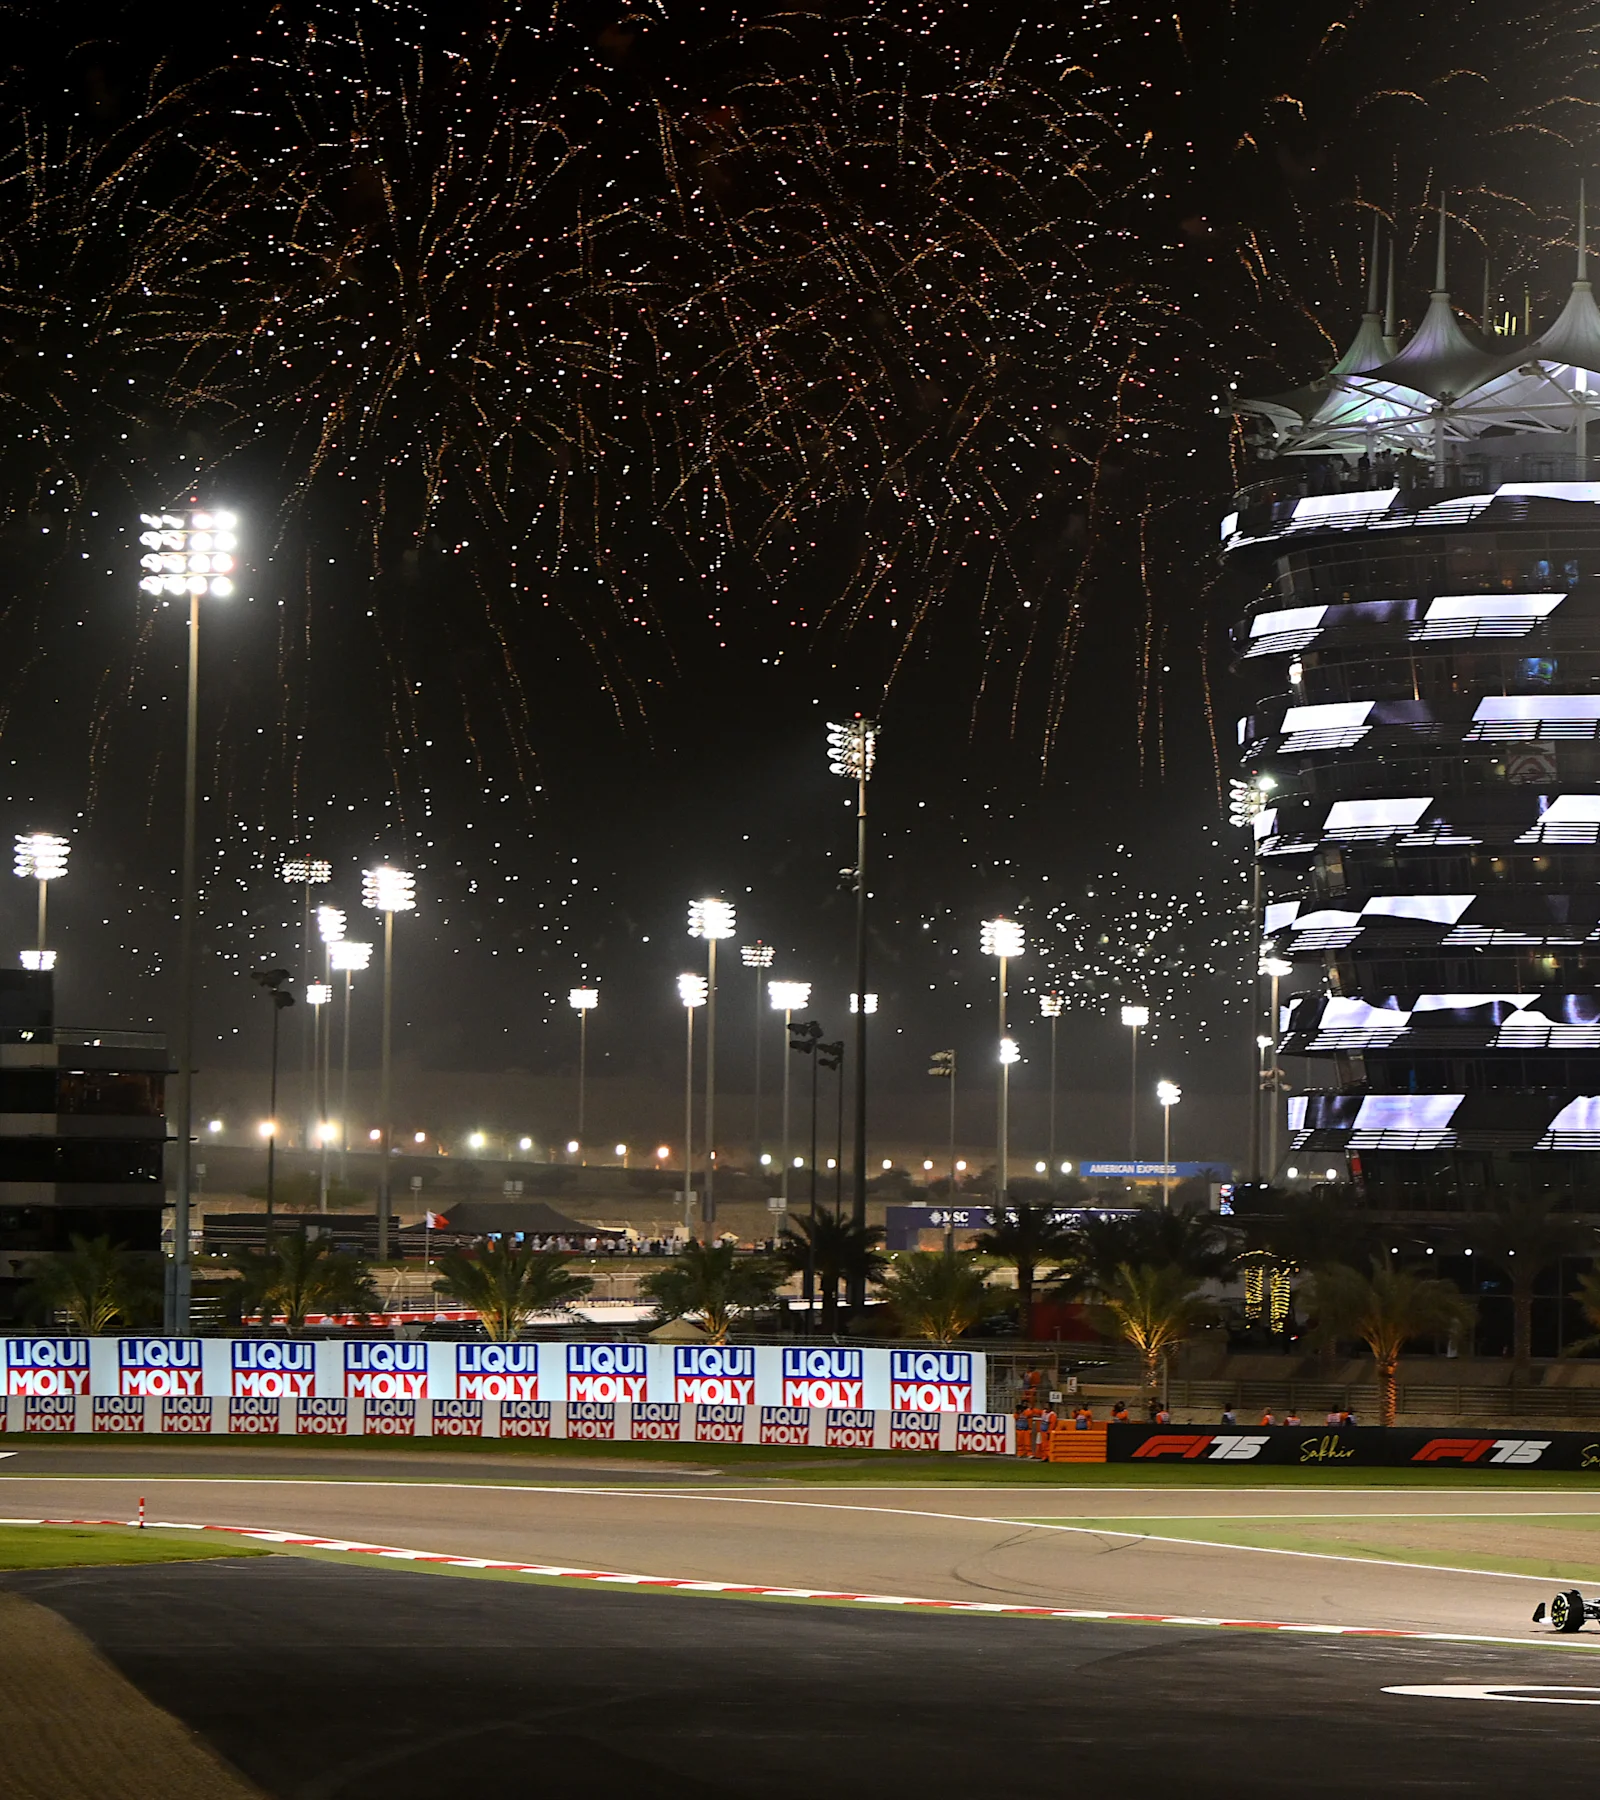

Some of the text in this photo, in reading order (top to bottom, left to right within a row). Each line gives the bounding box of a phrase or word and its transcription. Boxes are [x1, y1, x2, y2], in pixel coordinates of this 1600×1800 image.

[1089, 1164, 1177, 1174] AMERICAN EXPRESS
[8, 1341, 87, 1366] LIQUI
[122, 1341, 201, 1367] LIQUI
[234, 1342, 313, 1370] LIQUI
[347, 1344, 426, 1370] LIQUI
[458, 1346, 536, 1372] LIQUI
[568, 1346, 645, 1373] LIQUI
[676, 1348, 753, 1374] LIQUI
[785, 1350, 861, 1376] LIQUI
[893, 1352, 970, 1381] LIQUI
[8, 1369, 90, 1395] MOLY
[122, 1370, 204, 1395] MOLY
[234, 1372, 316, 1397] MOLY
[347, 1373, 429, 1398] MOLY
[458, 1375, 539, 1399] MOLY
[568, 1376, 648, 1400] MOLY
[676, 1379, 756, 1404] MOLY
[785, 1380, 864, 1407] MOLY
[893, 1384, 973, 1411] MOLY
[26, 1397, 74, 1413] LIQUI
[94, 1397, 143, 1414] LIQUI
[163, 1398, 211, 1414] LIQUI
[230, 1398, 278, 1415] LIQUI
[298, 1398, 346, 1416] LIQUI
[366, 1400, 414, 1416] LIQUI
[434, 1401, 481, 1418] LIQUI
[502, 1402, 550, 1419] LIQUI
[568, 1403, 614, 1420] LIQUI
[632, 1404, 679, 1421] LIQUI
[697, 1405, 743, 1422] LIQUI
[26, 1415, 74, 1430] MOLY
[94, 1415, 143, 1430] MOLY
[163, 1416, 211, 1431] MOLY
[230, 1416, 278, 1432] MOLY
[762, 1408, 808, 1424] LIQUI
[827, 1410, 874, 1428] LIQUI
[892, 1412, 939, 1430] LIQUI
[958, 1414, 1004, 1432] LIQUI
[298, 1417, 346, 1433] MOLY
[366, 1418, 414, 1434] MOLY
[434, 1419, 481, 1435] MOLY
[502, 1420, 550, 1436] MOLY
[568, 1421, 614, 1438] MOLY
[632, 1422, 679, 1439] MOLY
[697, 1424, 743, 1441] MOLY
[762, 1426, 808, 1443] MOLY
[827, 1429, 874, 1446] MOLY
[892, 1432, 939, 1449] MOLY
[958, 1434, 1004, 1451] MOLY
[1300, 1435, 1355, 1462] Sakhir
